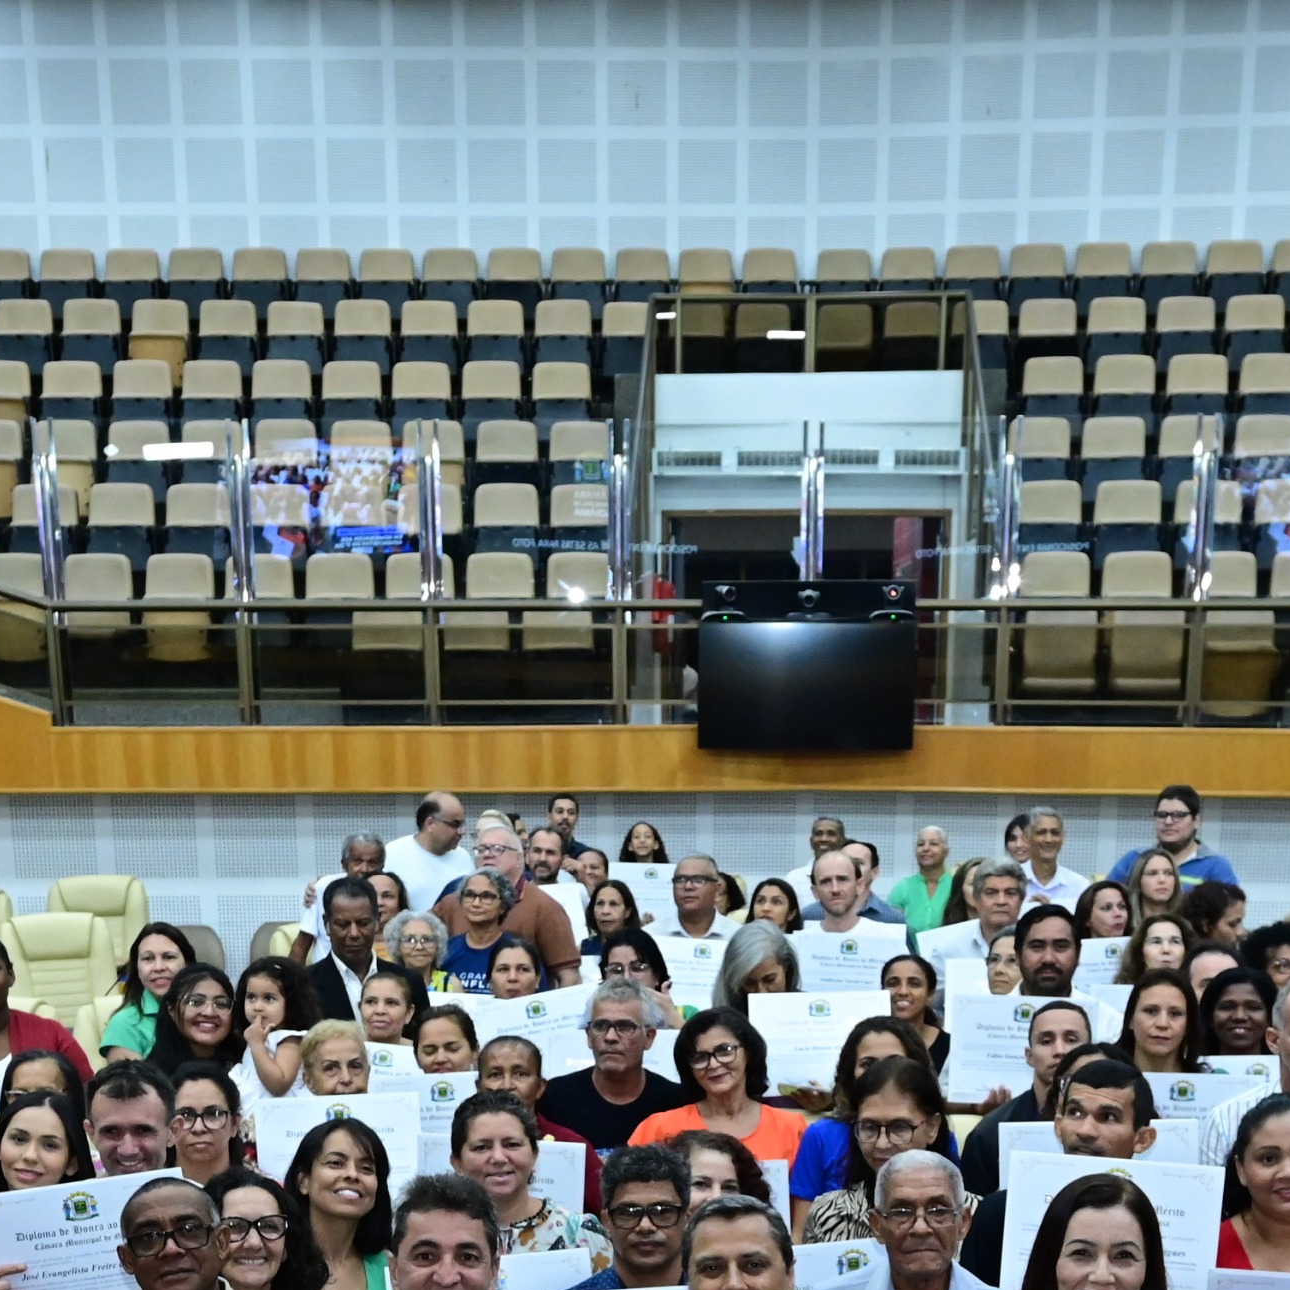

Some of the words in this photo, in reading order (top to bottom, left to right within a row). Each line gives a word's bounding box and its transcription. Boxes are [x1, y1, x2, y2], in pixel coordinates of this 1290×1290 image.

[15, 1231, 56, 1242] Diploma
[59, 1228, 69, 1236] de
[73, 1224, 104, 1235] Honra
[22, 1271, 39, 1282] José
[42, 1267, 89, 1278] Evangelista
[92, 1262, 117, 1271] Freire
